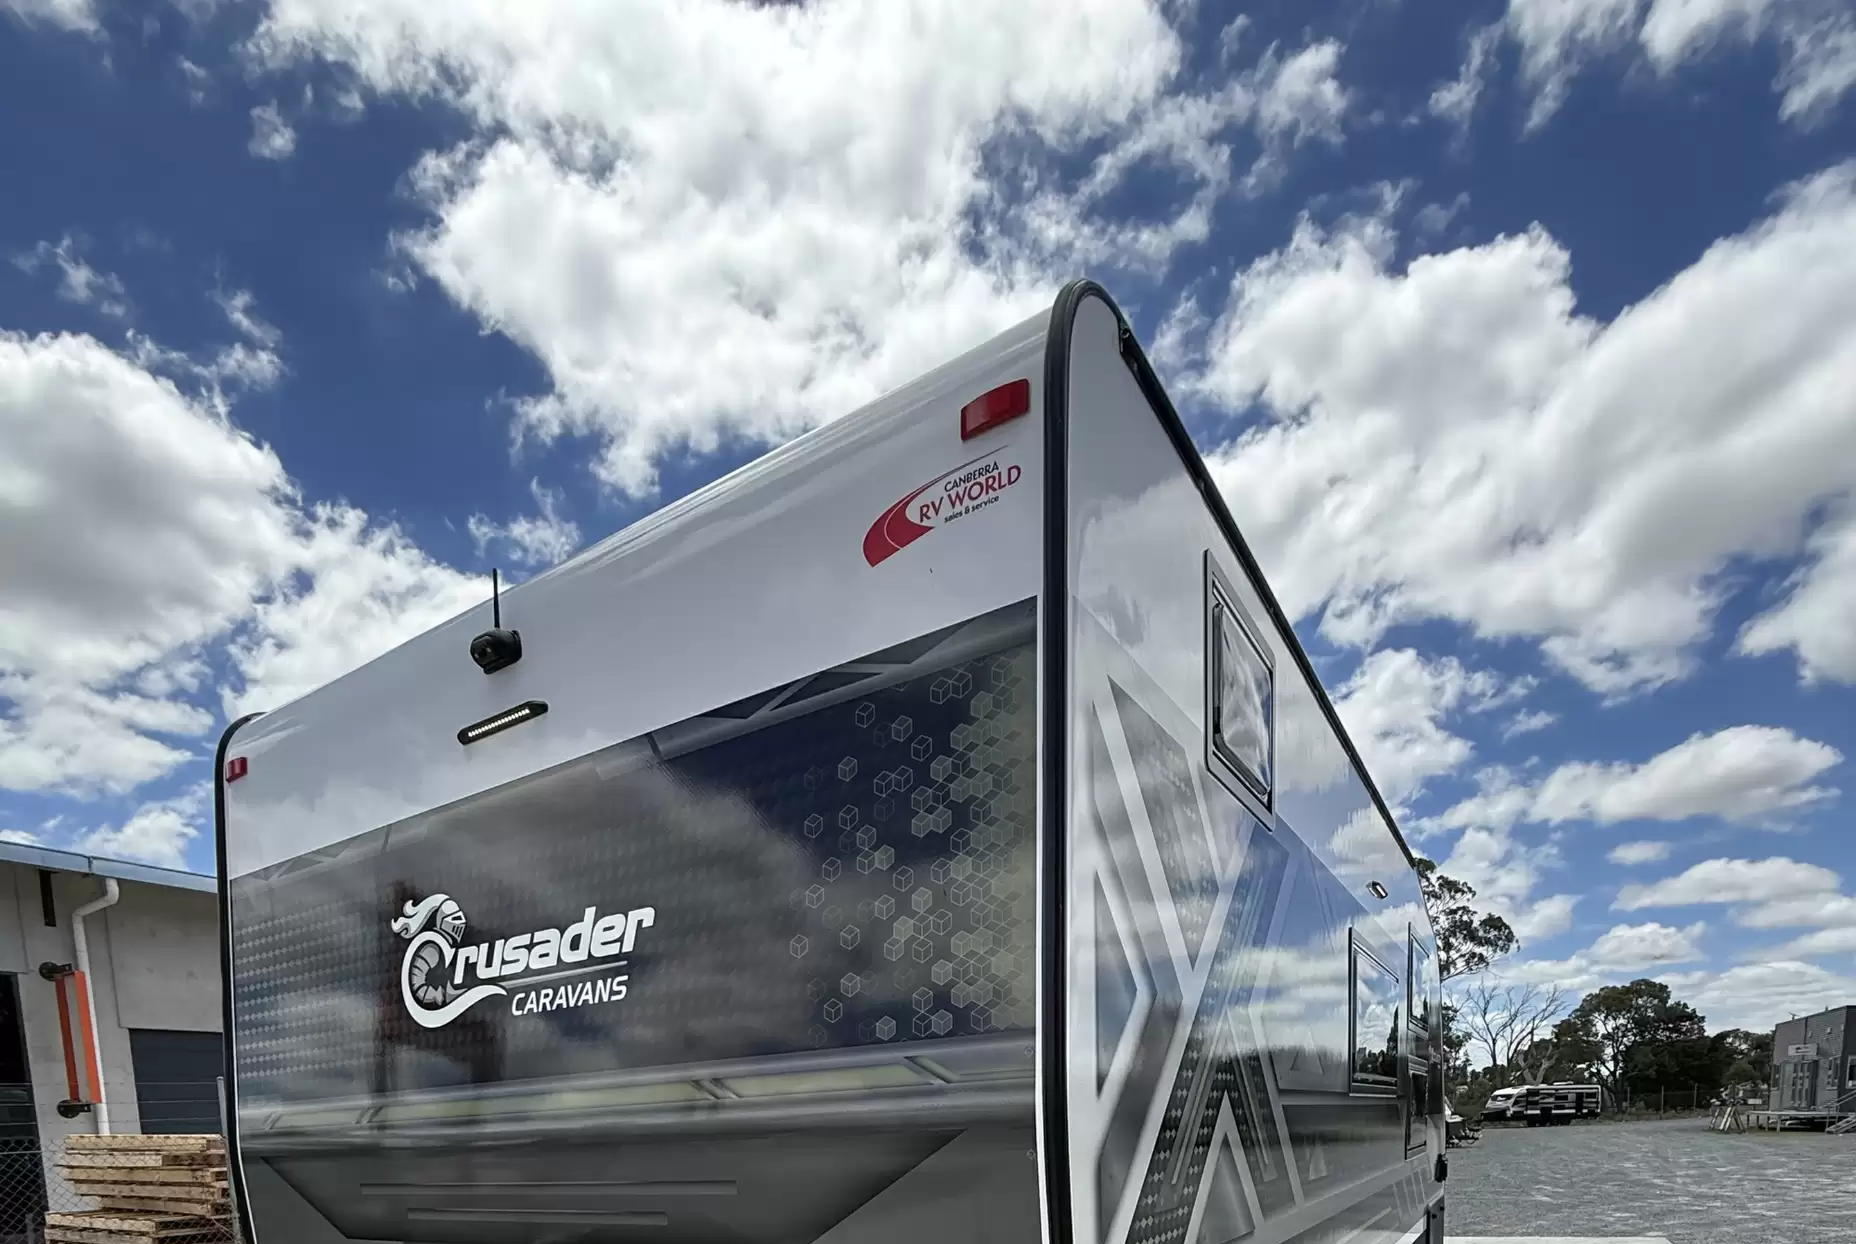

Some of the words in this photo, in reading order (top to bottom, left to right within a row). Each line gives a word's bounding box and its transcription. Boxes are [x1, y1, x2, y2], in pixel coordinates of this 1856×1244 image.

[919, 496, 945, 524] RV
[947, 464, 1022, 510] WORLD
[944, 460, 1000, 493] CANBERRA
[944, 508, 964, 524] sales
[964, 505, 971, 516] &
[971, 495, 1000, 513] service
[401, 905, 656, 1029] Crusader
[511, 975, 629, 1016] CARAVANS
